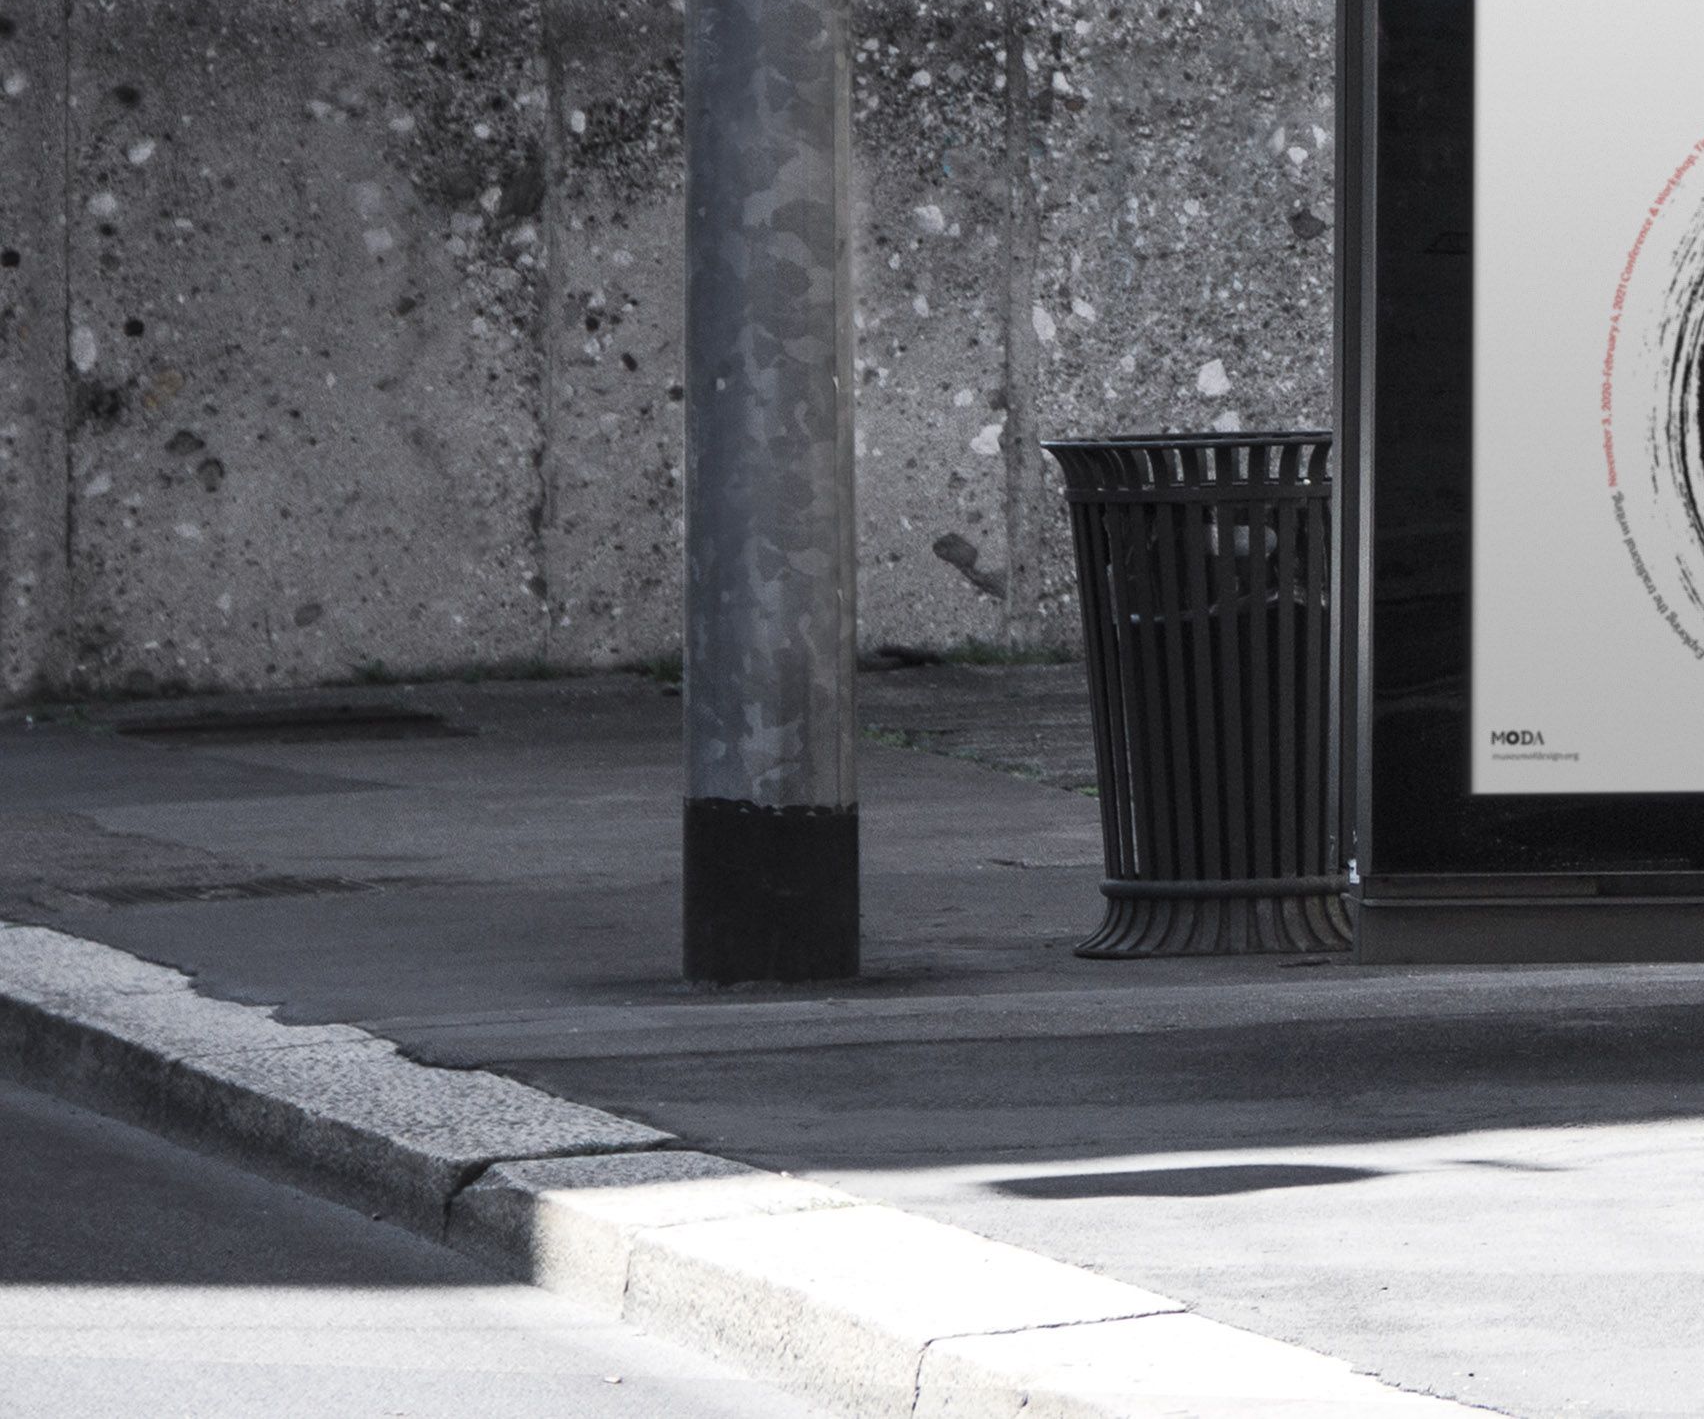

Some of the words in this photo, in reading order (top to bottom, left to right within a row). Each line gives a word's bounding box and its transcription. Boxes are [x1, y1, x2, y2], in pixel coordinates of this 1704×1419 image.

[1611, 283, 1627, 310] 2021
[1650, 593, 1669, 615] the
[1490, 730, 1545, 745] MODA
